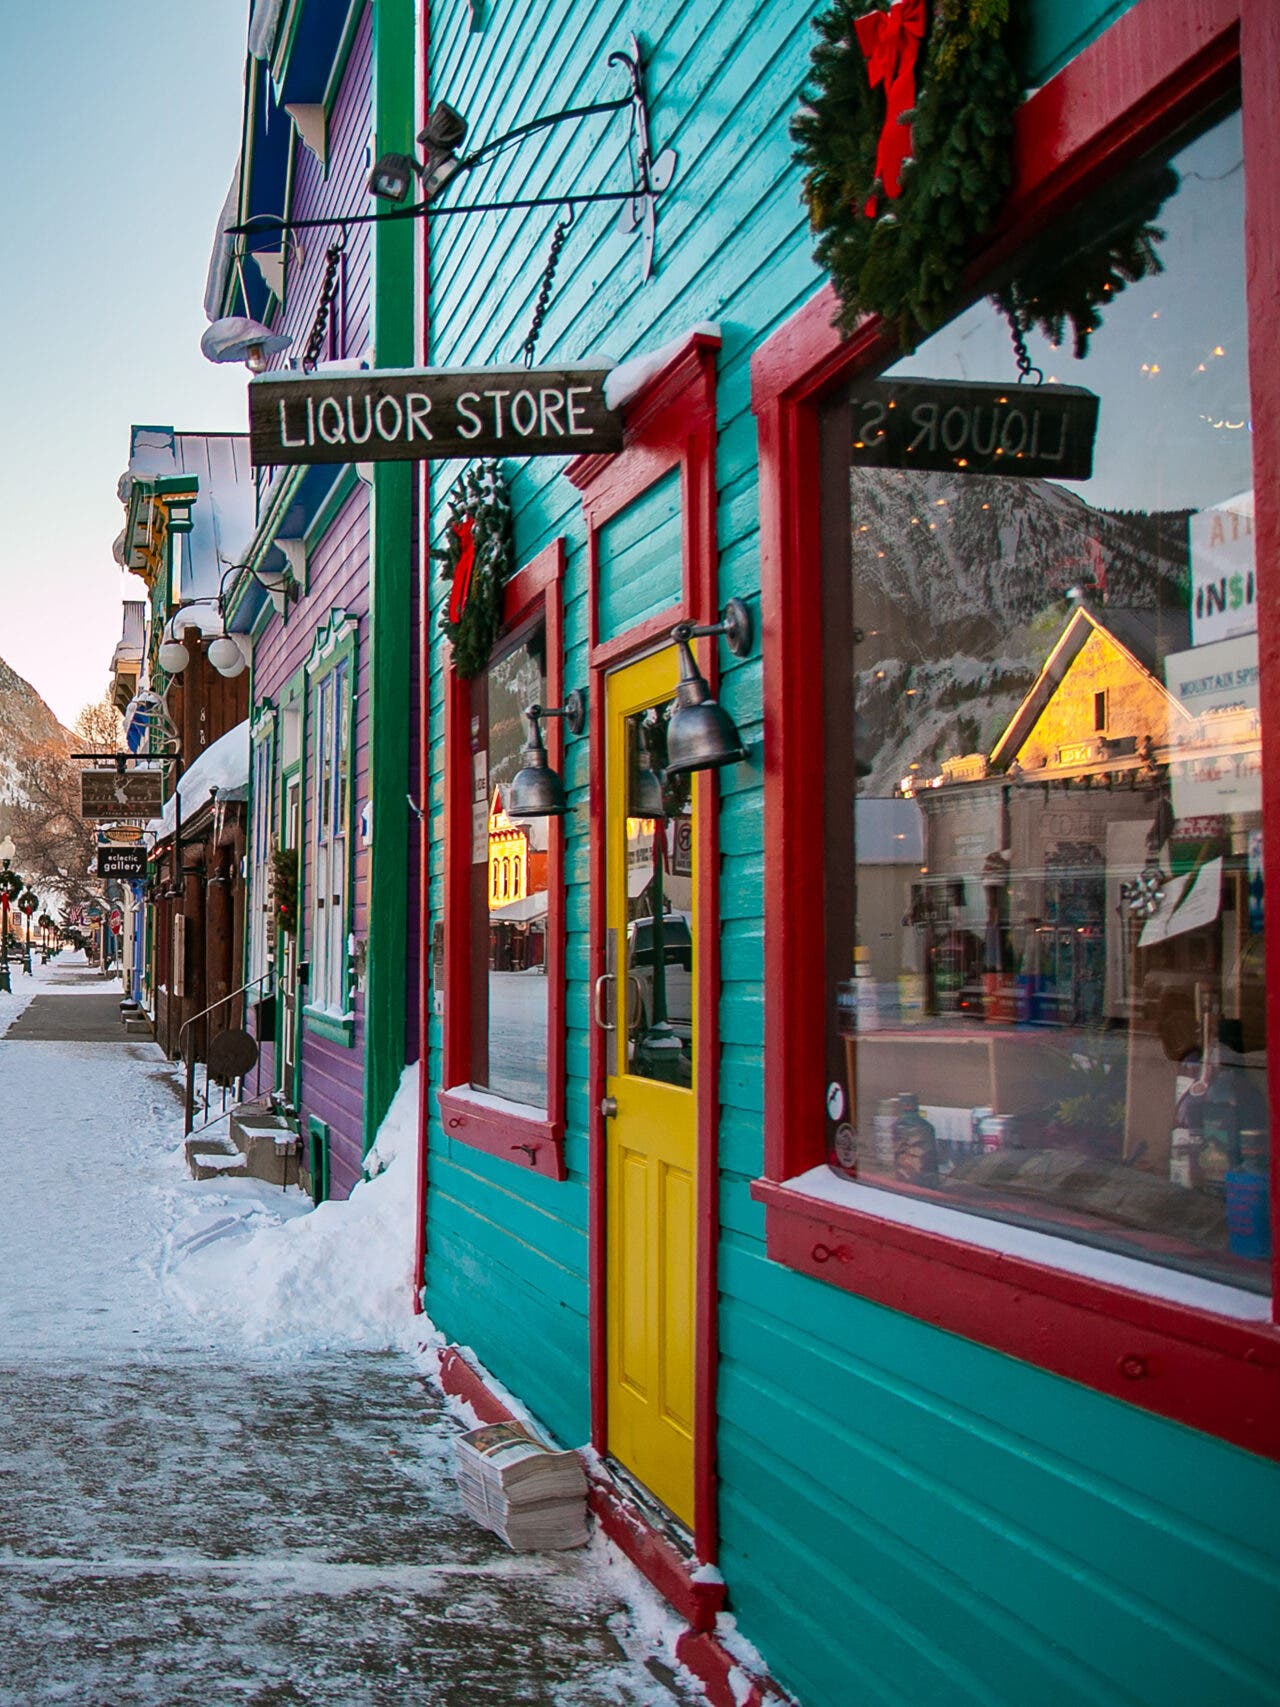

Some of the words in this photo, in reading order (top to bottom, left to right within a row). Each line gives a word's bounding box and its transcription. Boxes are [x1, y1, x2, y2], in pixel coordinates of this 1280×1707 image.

[278, 392, 433, 448] LIQUOR
[455, 386, 595, 440] STORE
[1179, 671, 1234, 696] MOUNTAIN
[107, 853, 138, 862] eclectic
[103, 861, 142, 873] gallery
